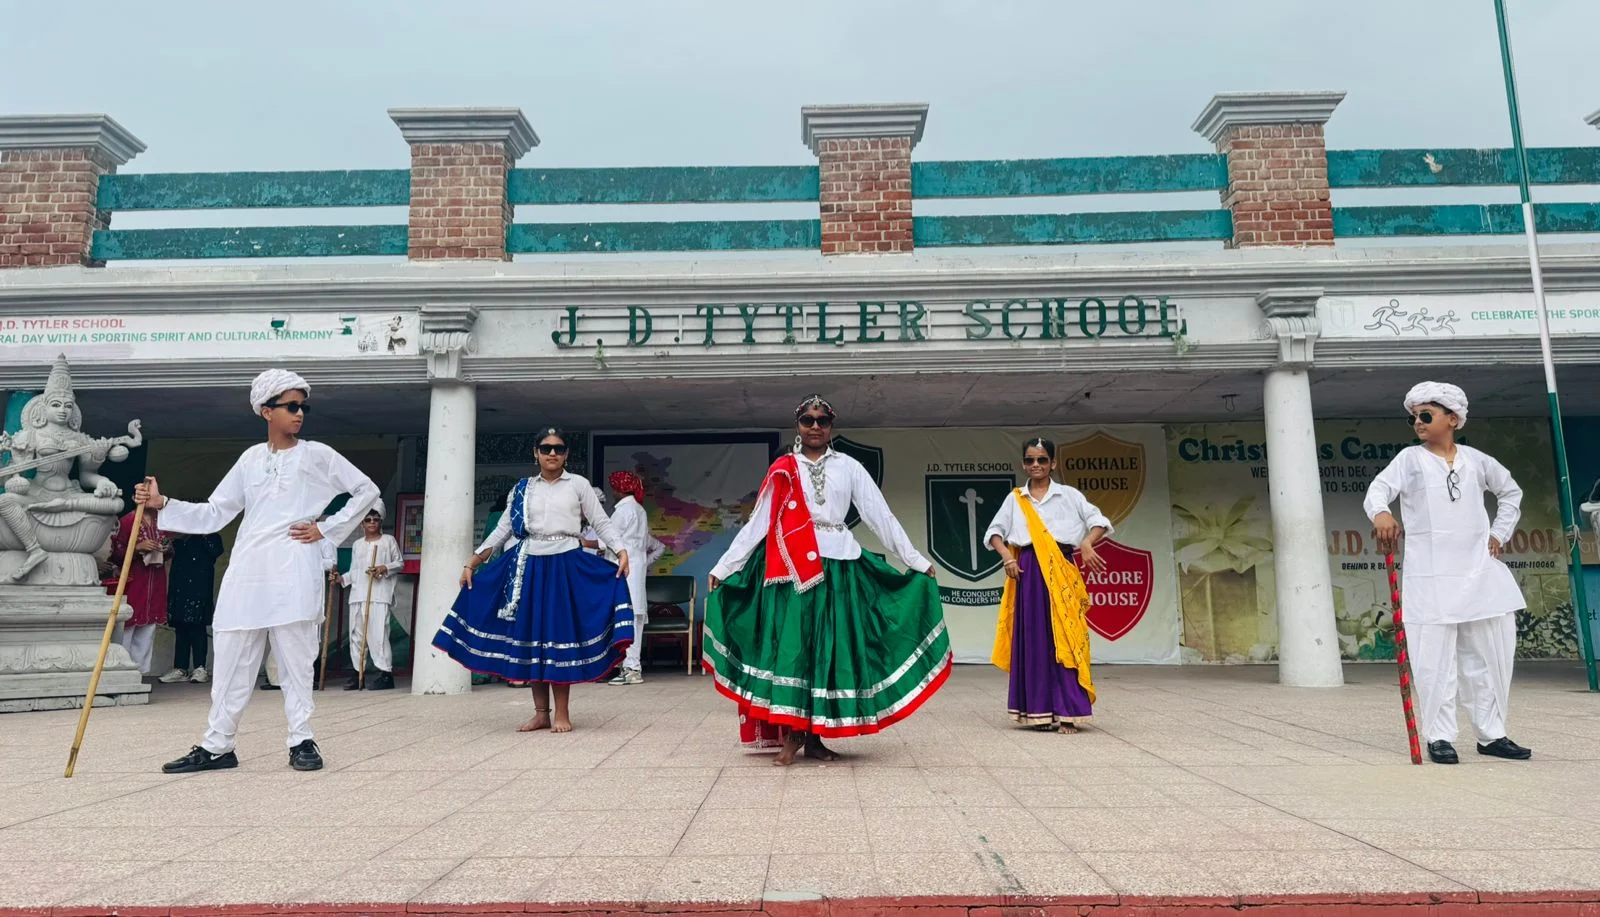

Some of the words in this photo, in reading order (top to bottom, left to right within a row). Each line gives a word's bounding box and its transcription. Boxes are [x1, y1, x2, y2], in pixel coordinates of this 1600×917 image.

[1569, 308, 1600, 319] SPOR
[22, 319, 69, 330] TYTLER
[73, 317, 126, 329] SCHOOL
[697, 300, 927, 347] TYTLER
[964, 294, 1188, 341] SCHOOL
[21, 333, 44, 344] DAY
[46, 333, 77, 343] WITH
[79, 333, 88, 343] A
[91, 332, 148, 343] SPORTING
[150, 331, 186, 342] SPIRIT
[187, 331, 212, 341] AND
[215, 330, 273, 341] CULTURAL
[275, 329, 334, 340] HARMONY
[927, 463, 942, 472] J.D.
[944, 463, 975, 472] TYTLER
[977, 462, 1014, 472] SCHOOL
[1065, 456, 1138, 471] GOKHALE
[1077, 477, 1129, 491] HOUSE
[1324, 481, 1338, 493] TO
[1341, 481, 1365, 493] 5:00
[1341, 562, 1368, 571] BEHIND
[1370, 562, 1377, 571] R
[951, 596, 989, 604] CONQUERS
[962, 590, 1000, 598] CONQUERS
